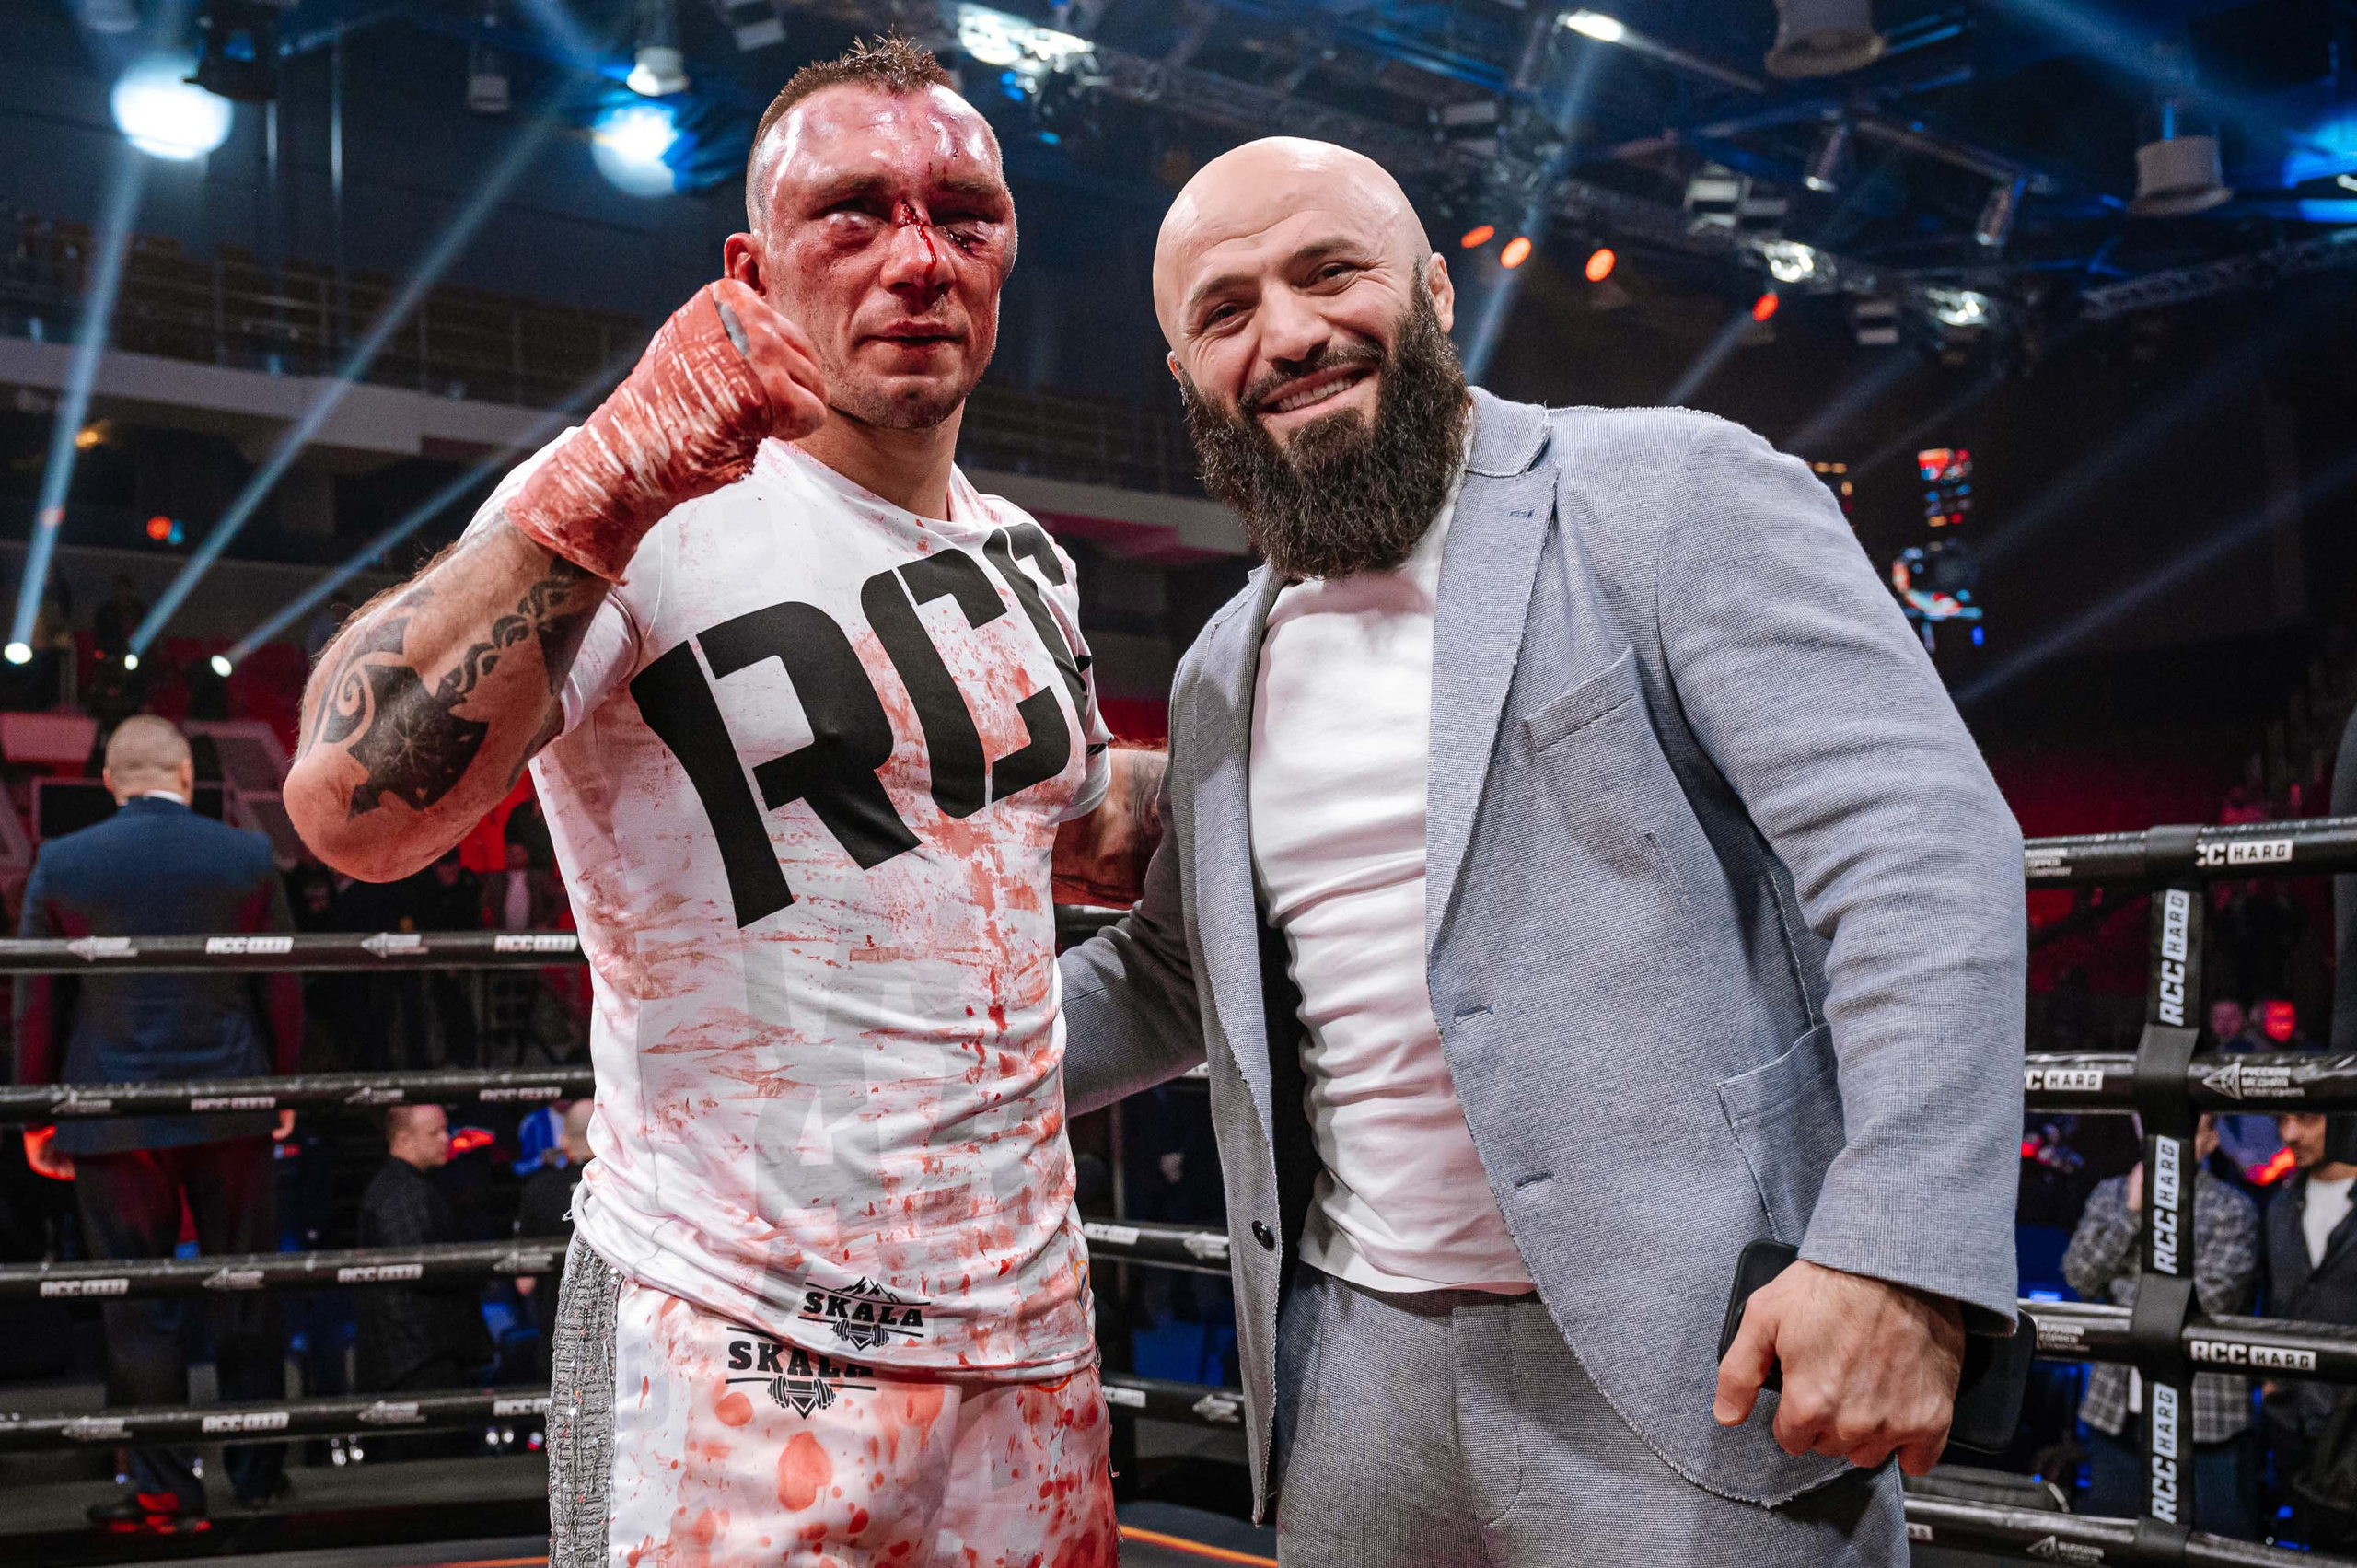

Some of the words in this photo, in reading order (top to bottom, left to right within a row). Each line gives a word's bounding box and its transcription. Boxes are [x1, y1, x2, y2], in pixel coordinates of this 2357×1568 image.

[2232, 842, 2289, 862] HARD
[2165, 892, 2187, 957] HARD
[2160, 959, 2185, 1027] RCC
[2156, 1140, 2177, 1205] HARD
[2154, 1208, 2177, 1275] RCC
[803, 1291, 923, 1327] SKALA
[2190, 1340, 2247, 1364] RCC
[2152, 1456, 2177, 1524] RCC
